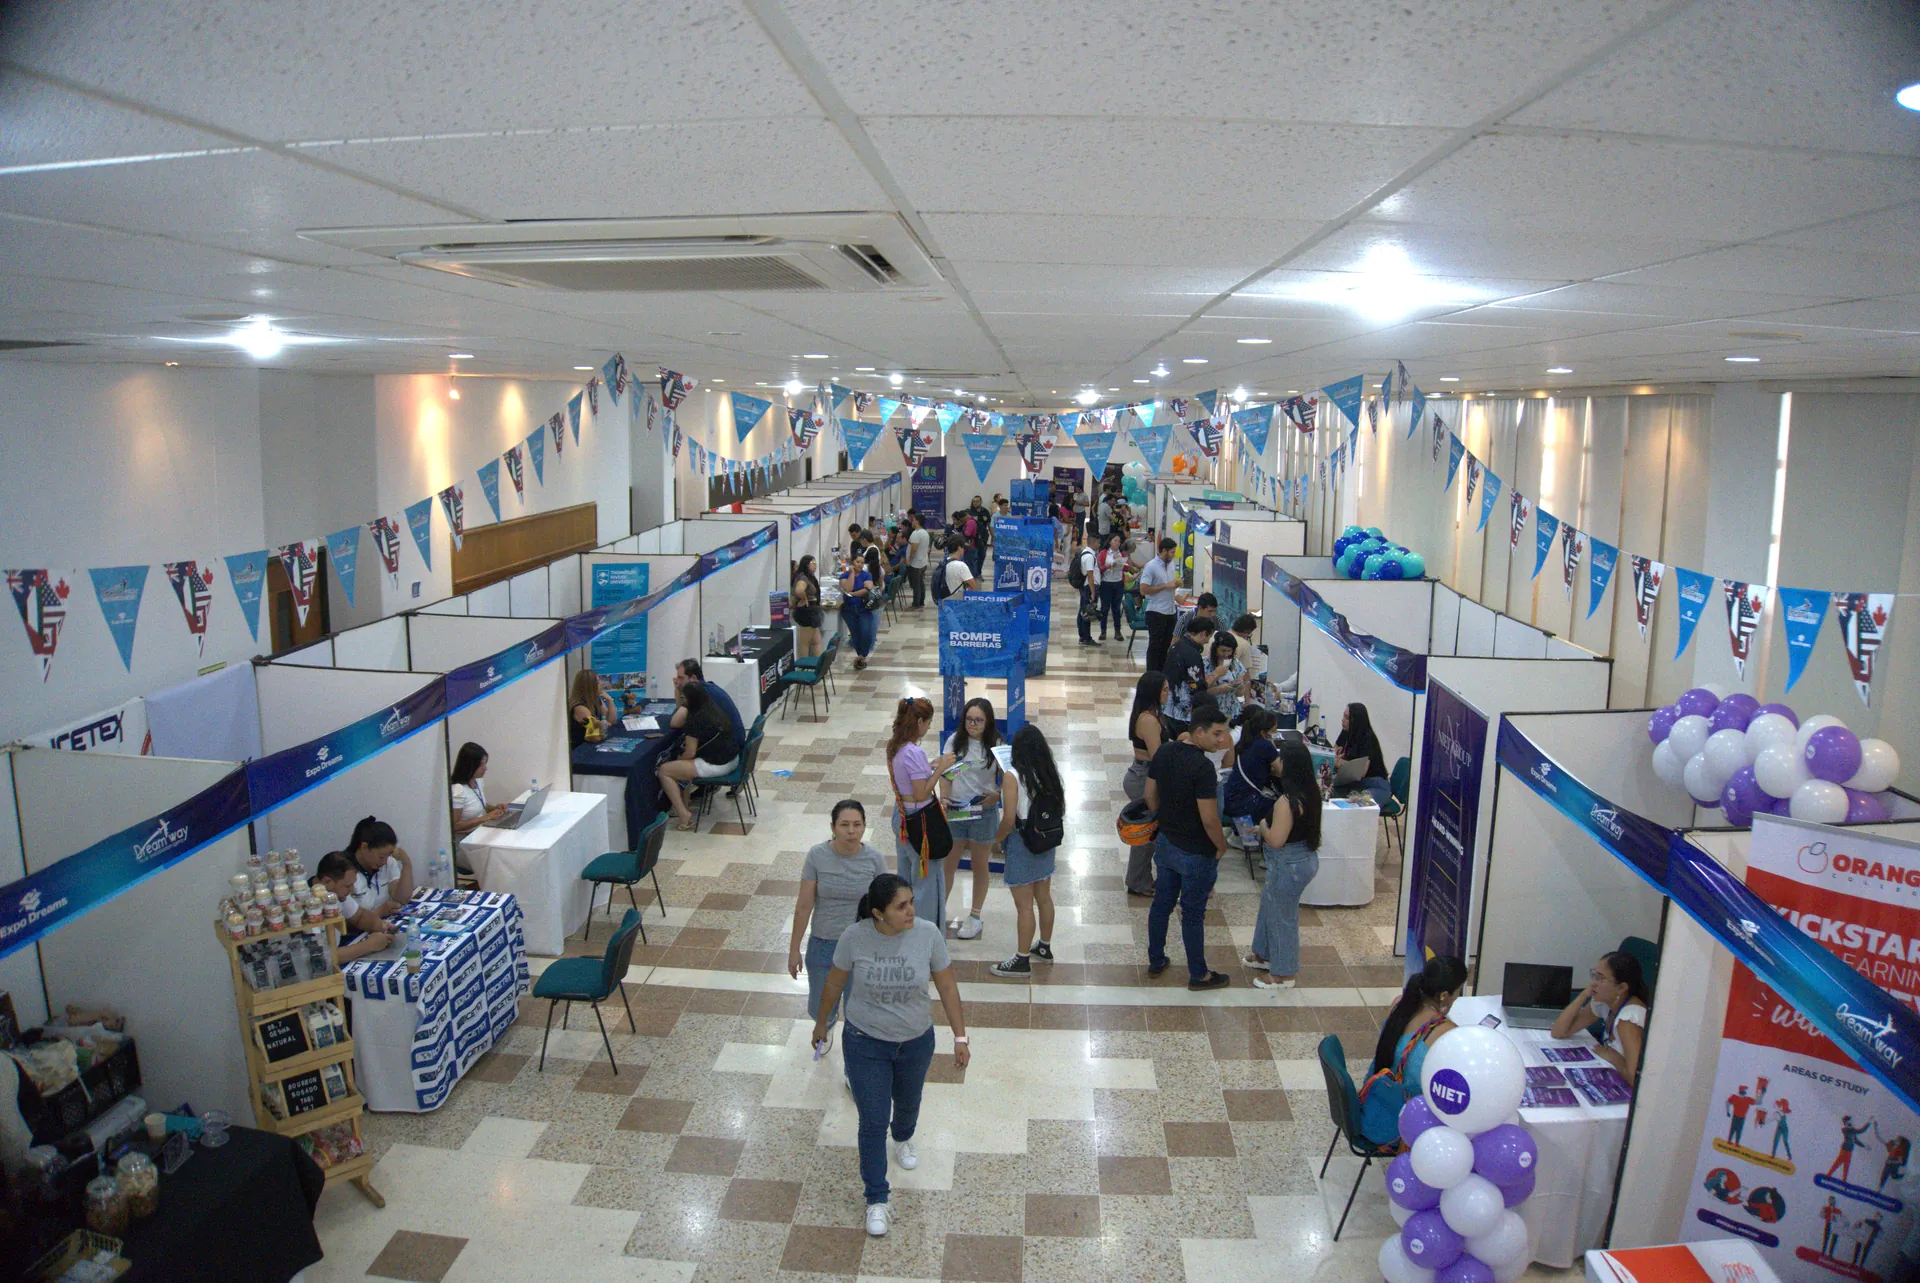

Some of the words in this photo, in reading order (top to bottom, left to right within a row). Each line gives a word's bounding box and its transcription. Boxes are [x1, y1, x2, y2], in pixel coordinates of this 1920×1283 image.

[950, 632, 1001, 642] ROMPE
[950, 641, 1002, 649] BARRERAS
[305, 766, 321, 778] Expo
[321, 754, 343, 770] Dreams
[168, 825, 188, 841] way
[0, 918, 27, 938] Expo
[28, 897, 68, 922] Dreams
[867, 966, 916, 982] MIND
[869, 991, 912, 1004] REAL
[266, 1035, 296, 1050] NATURAL
[1835, 1003, 1873, 1043] Dream
[1875, 1038, 1903, 1069] way
[288, 1076, 318, 1091] BOURBON
[1783, 1064, 1818, 1080] AREAS
[1820, 1074, 1834, 1084] OF
[1834, 1079, 1870, 1096] STUDY
[292, 1085, 318, 1099] ROSADO
[1432, 1081, 1467, 1105] NIET
